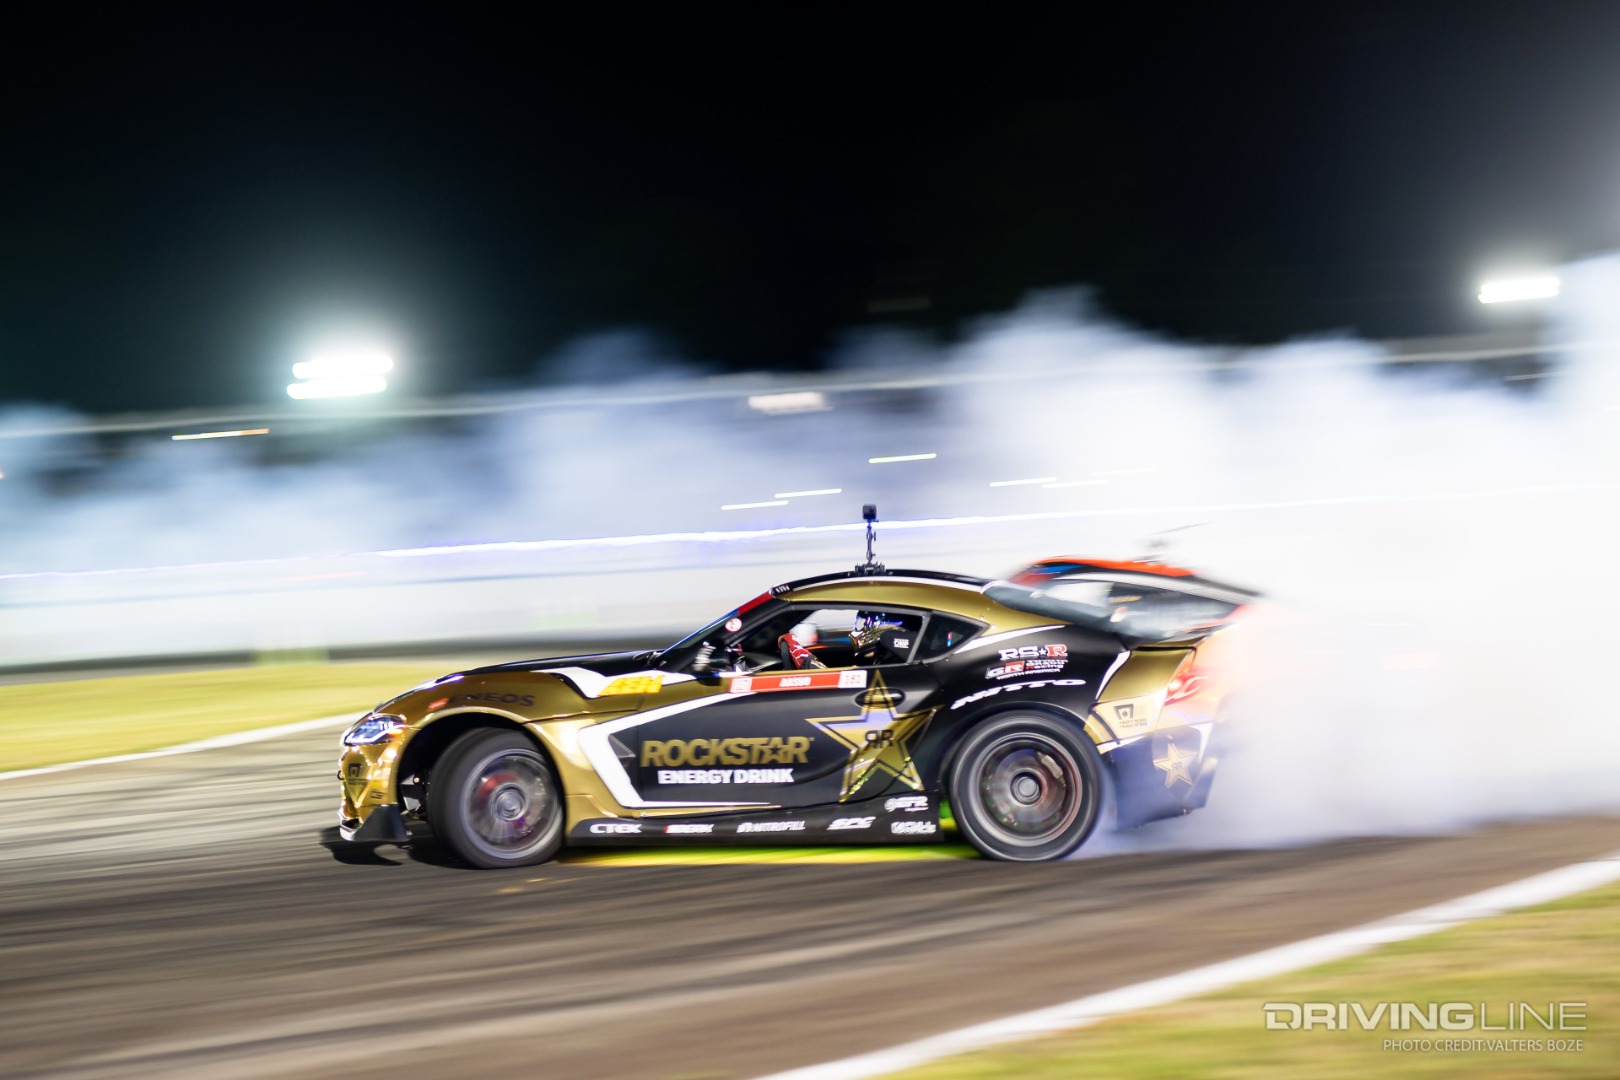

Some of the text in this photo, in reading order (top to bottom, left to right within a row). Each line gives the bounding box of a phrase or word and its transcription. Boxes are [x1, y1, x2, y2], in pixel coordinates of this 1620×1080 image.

[985, 661, 1025, 679] GR
[448, 692, 536, 707] ENEOS
[640, 736, 811, 767] ROCKSTAR
[657, 767, 794, 784] ENERGY DRINK
[590, 823, 642, 834] CTEK
